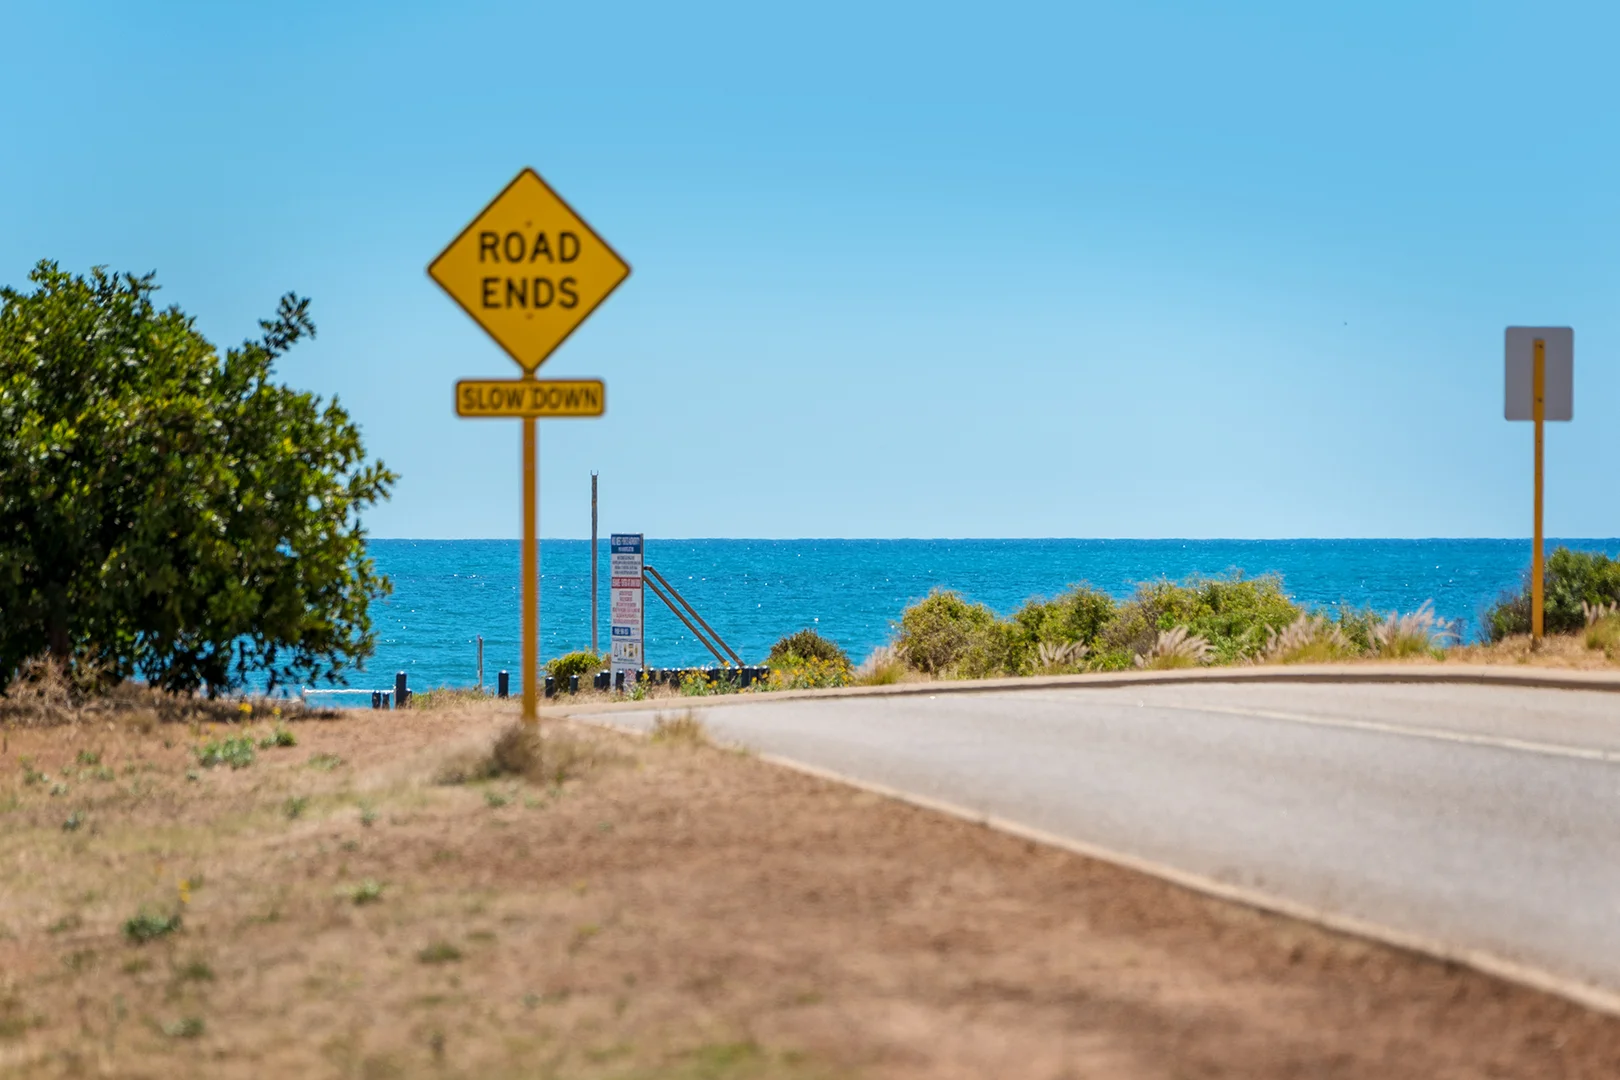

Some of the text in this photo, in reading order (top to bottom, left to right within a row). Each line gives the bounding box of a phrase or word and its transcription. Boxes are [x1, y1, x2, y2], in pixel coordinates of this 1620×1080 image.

[479, 231, 581, 263] ROAD
[483, 277, 579, 309] ENDS
[463, 387, 598, 410] SLOW DOWN
